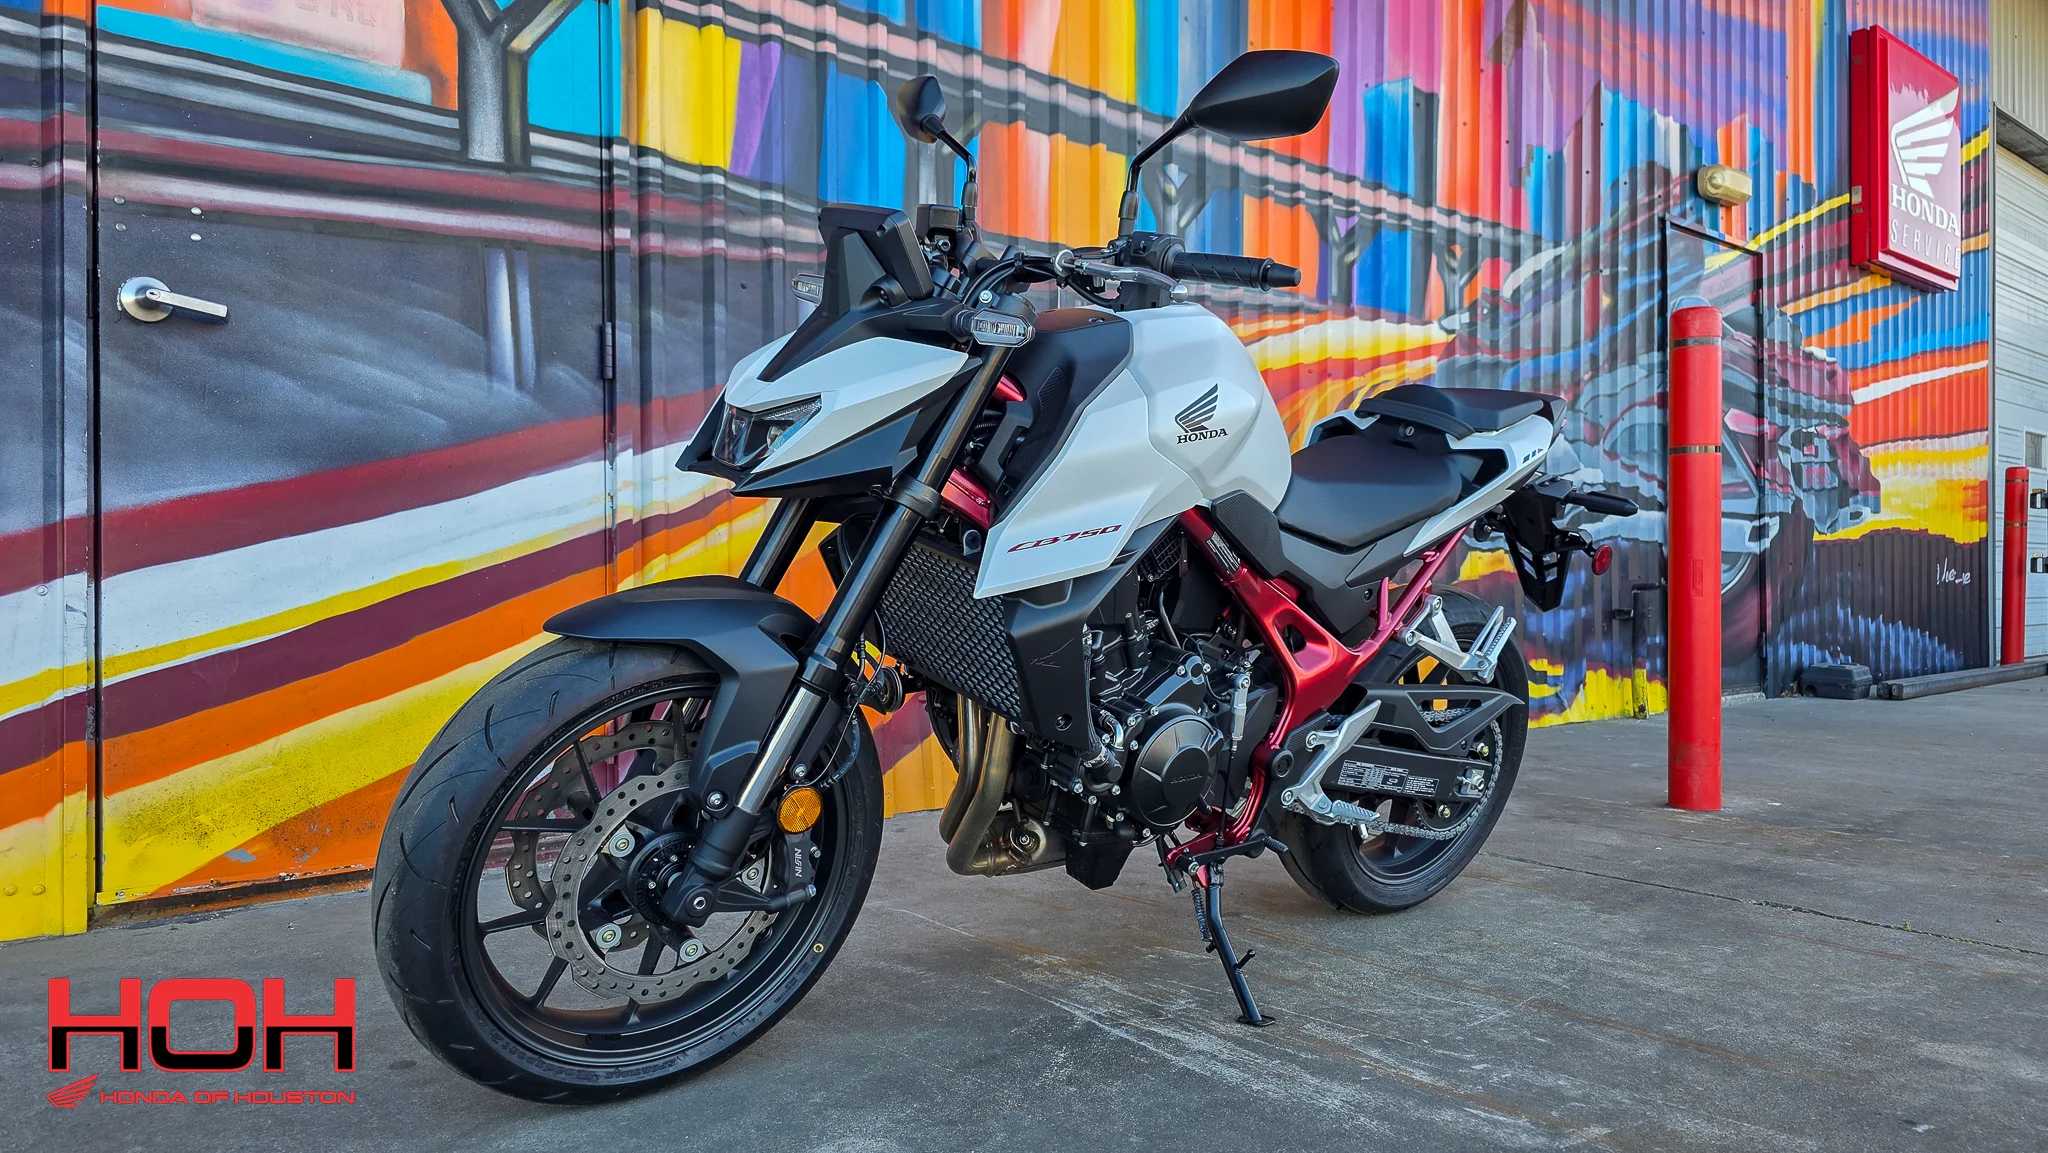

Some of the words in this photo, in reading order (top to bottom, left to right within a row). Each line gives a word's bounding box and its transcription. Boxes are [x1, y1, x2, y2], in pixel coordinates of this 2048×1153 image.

[1890, 183, 1961, 238] HONDA
[1890, 218, 1961, 271] SERVICE
[1176, 427, 1228, 444] HONDA
[1007, 524, 1122, 553] CB750
[794, 847, 802, 878] NISSIN
